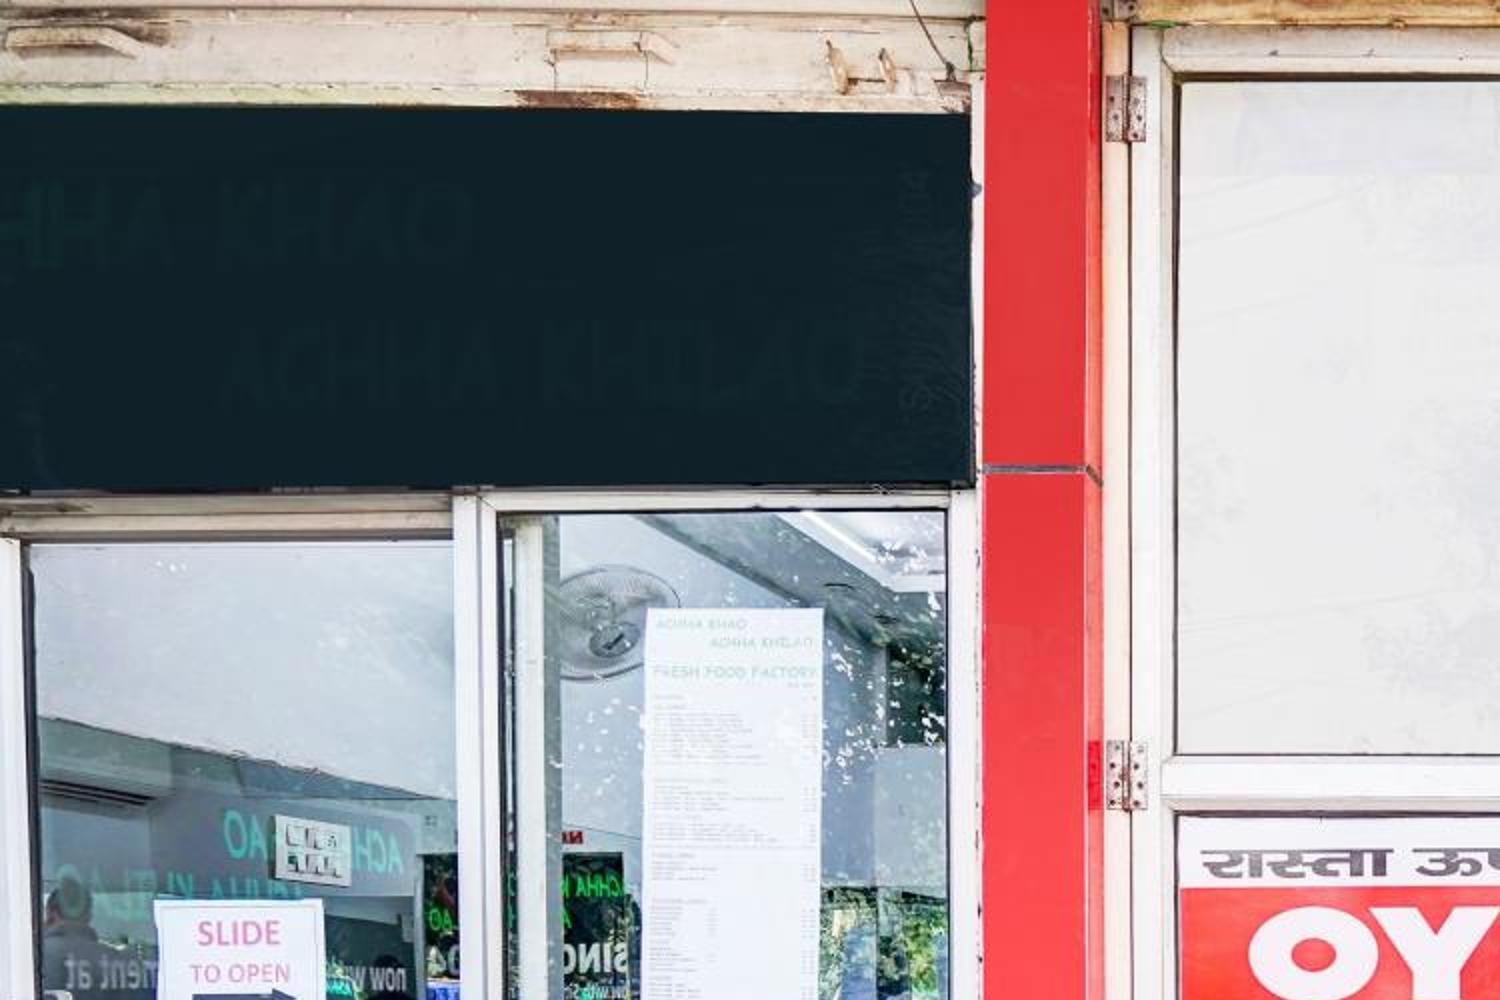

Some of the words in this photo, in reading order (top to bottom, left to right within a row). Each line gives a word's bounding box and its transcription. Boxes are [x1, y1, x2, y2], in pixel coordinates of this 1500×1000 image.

[704, 665, 747, 679] FOOD
[1201, 848, 1394, 878] रास्ता
[197, 920, 281, 946] SLIDE
[189, 964, 221, 984] TO
[229, 963, 290, 983] OPEN
